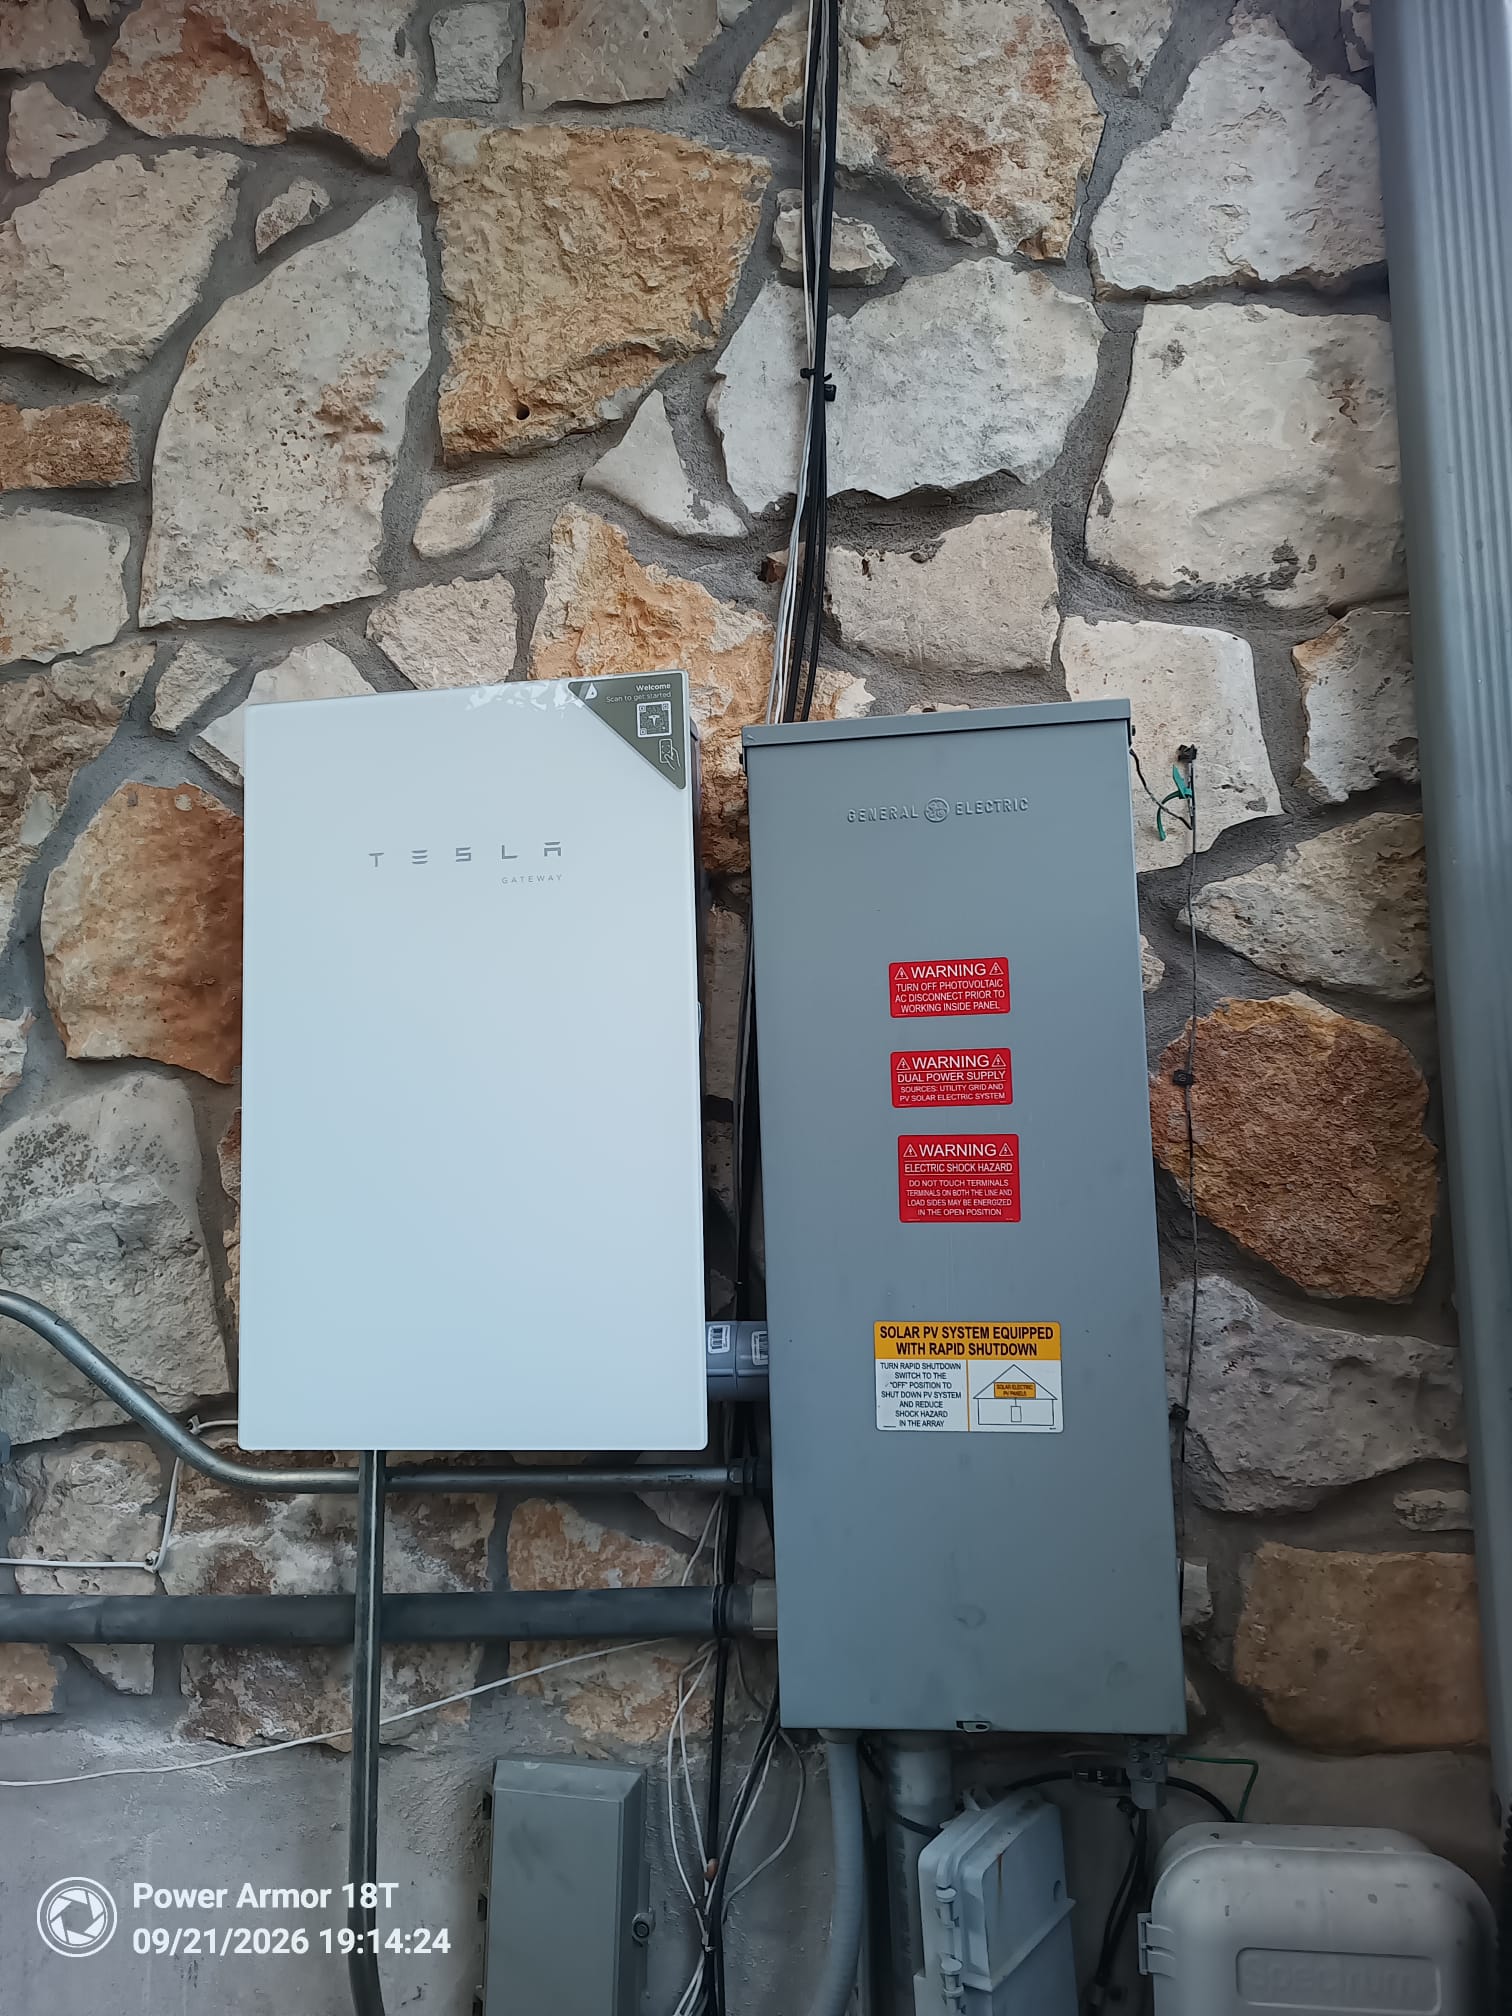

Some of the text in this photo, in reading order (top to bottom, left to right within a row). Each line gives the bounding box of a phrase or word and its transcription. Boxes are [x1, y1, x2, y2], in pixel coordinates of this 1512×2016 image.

[635, 684, 671, 692] Welcome
[633, 694, 645, 702] get
[647, 691, 671, 699] started
[847, 805, 919, 823] GENERAL
[955, 797, 1029, 815] ELECTRIC
[368, 841, 562, 868] TESLA
[501, 874, 563, 884] GATEWAY
[910, 963, 987, 979] WARNING
[896, 979, 1004, 992] TURN OFF PHOTOVOLTAIC
[895, 990, 1005, 1002] AC DISCONNECT PRIOR TO
[901, 1001, 1000, 1013] WORKING INSIDE PANEL
[912, 1054, 990, 1070] WARNING
[898, 1070, 1006, 1083] DUAL POWER SUPPLY
[940, 1084, 967, 1092] UTILITY
[912, 1094, 936, 1102] SOLAR
[938, 1093, 974, 1101] ELECTRIC
[975, 1092, 1006, 1100] SYSTEM
[919, 1144, 997, 1157] WARNING
[904, 1162, 1012, 1172] ELECTRIC SHOCK HAZARD
[967, 1179, 1009, 1187] TERMINALS
[907, 1199, 926, 1207] LOAD
[966, 1208, 1002, 1216] POSITION
[880, 1326, 1054, 1340] SOLAR PV SYSTEM EQUIPPED
[896, 1342, 1037, 1356] WITH RAPID SHUTDOWN
[880, 1362, 898, 1370] TURN
[900, 1362, 920, 1370] RAPID
[933, 1372, 947, 1380] THE
[895, 1410, 919, 1418] SHOCK
